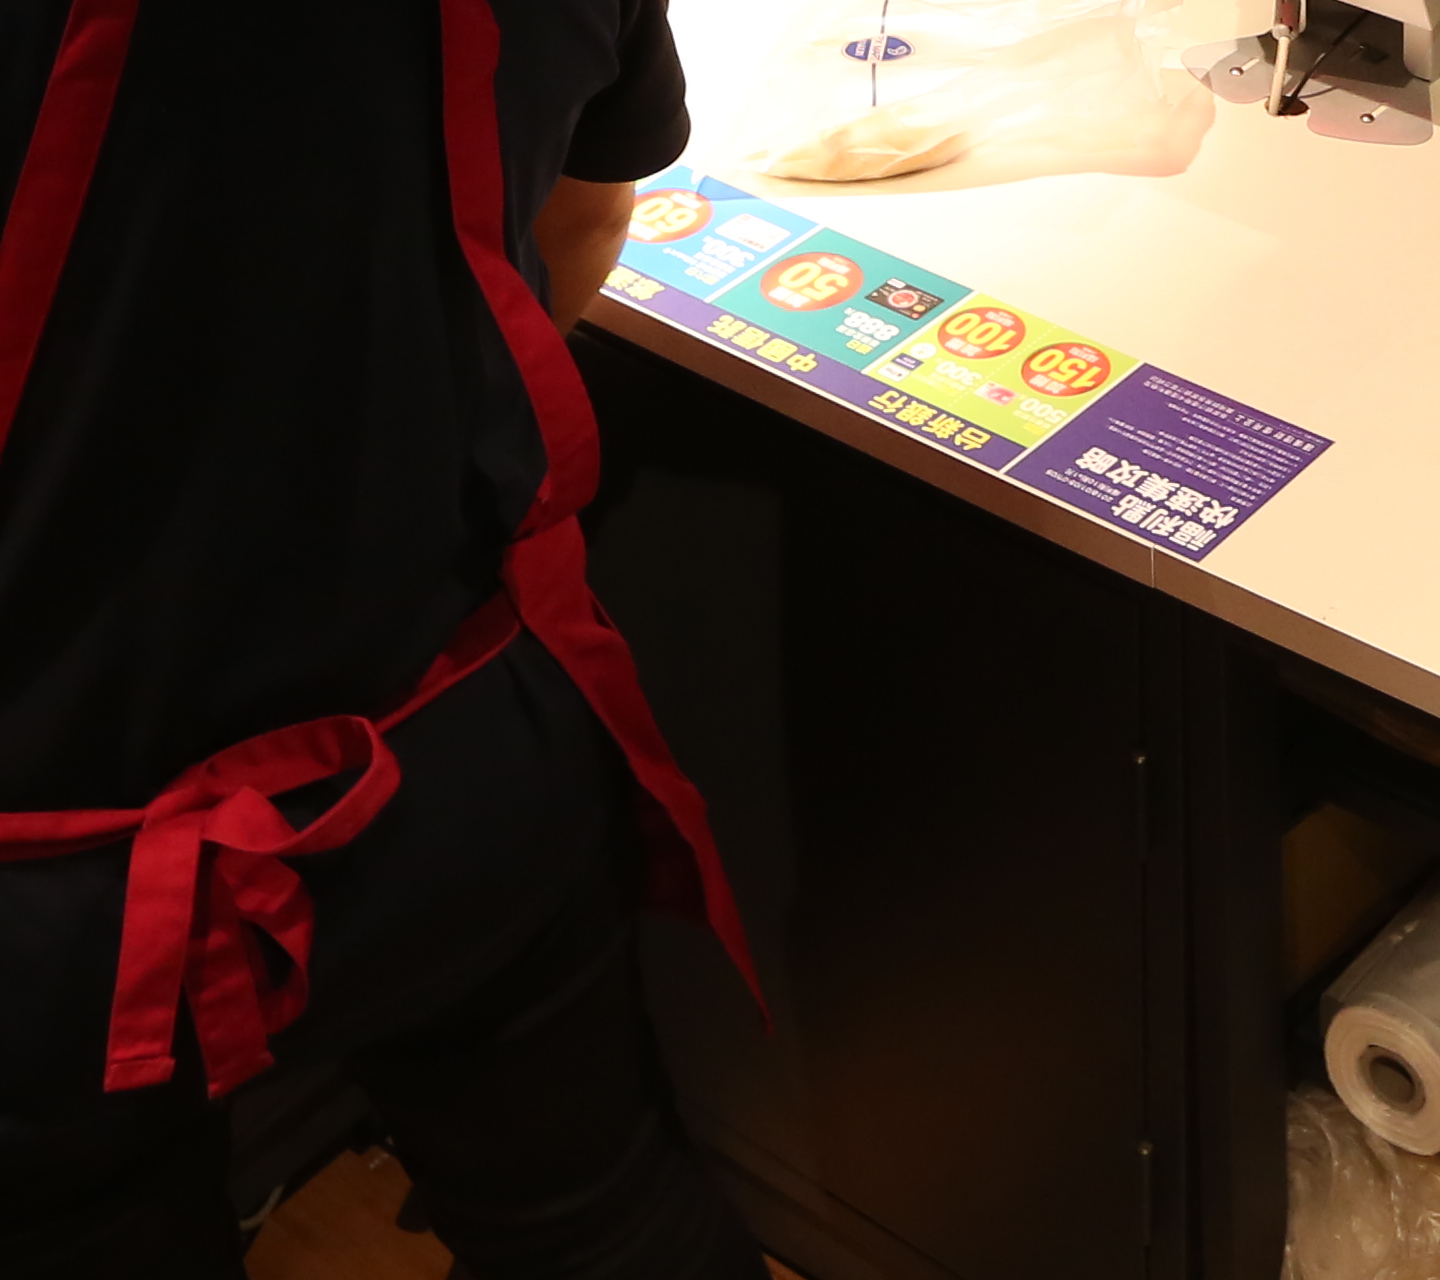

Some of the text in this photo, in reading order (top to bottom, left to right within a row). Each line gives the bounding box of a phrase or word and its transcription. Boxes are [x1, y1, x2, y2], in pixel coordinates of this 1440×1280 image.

[634, 195, 698, 235] 60
[777, 262, 850, 300] 50
[706, 314, 820, 375] 中國信託
[944, 312, 1022, 353] 100
[1028, 348, 1108, 391] 150
[867, 390, 992, 452] 台新銀行
[1074, 447, 1237, 528] 快速集攻略
[1111, 493, 1220, 552] 福利點
